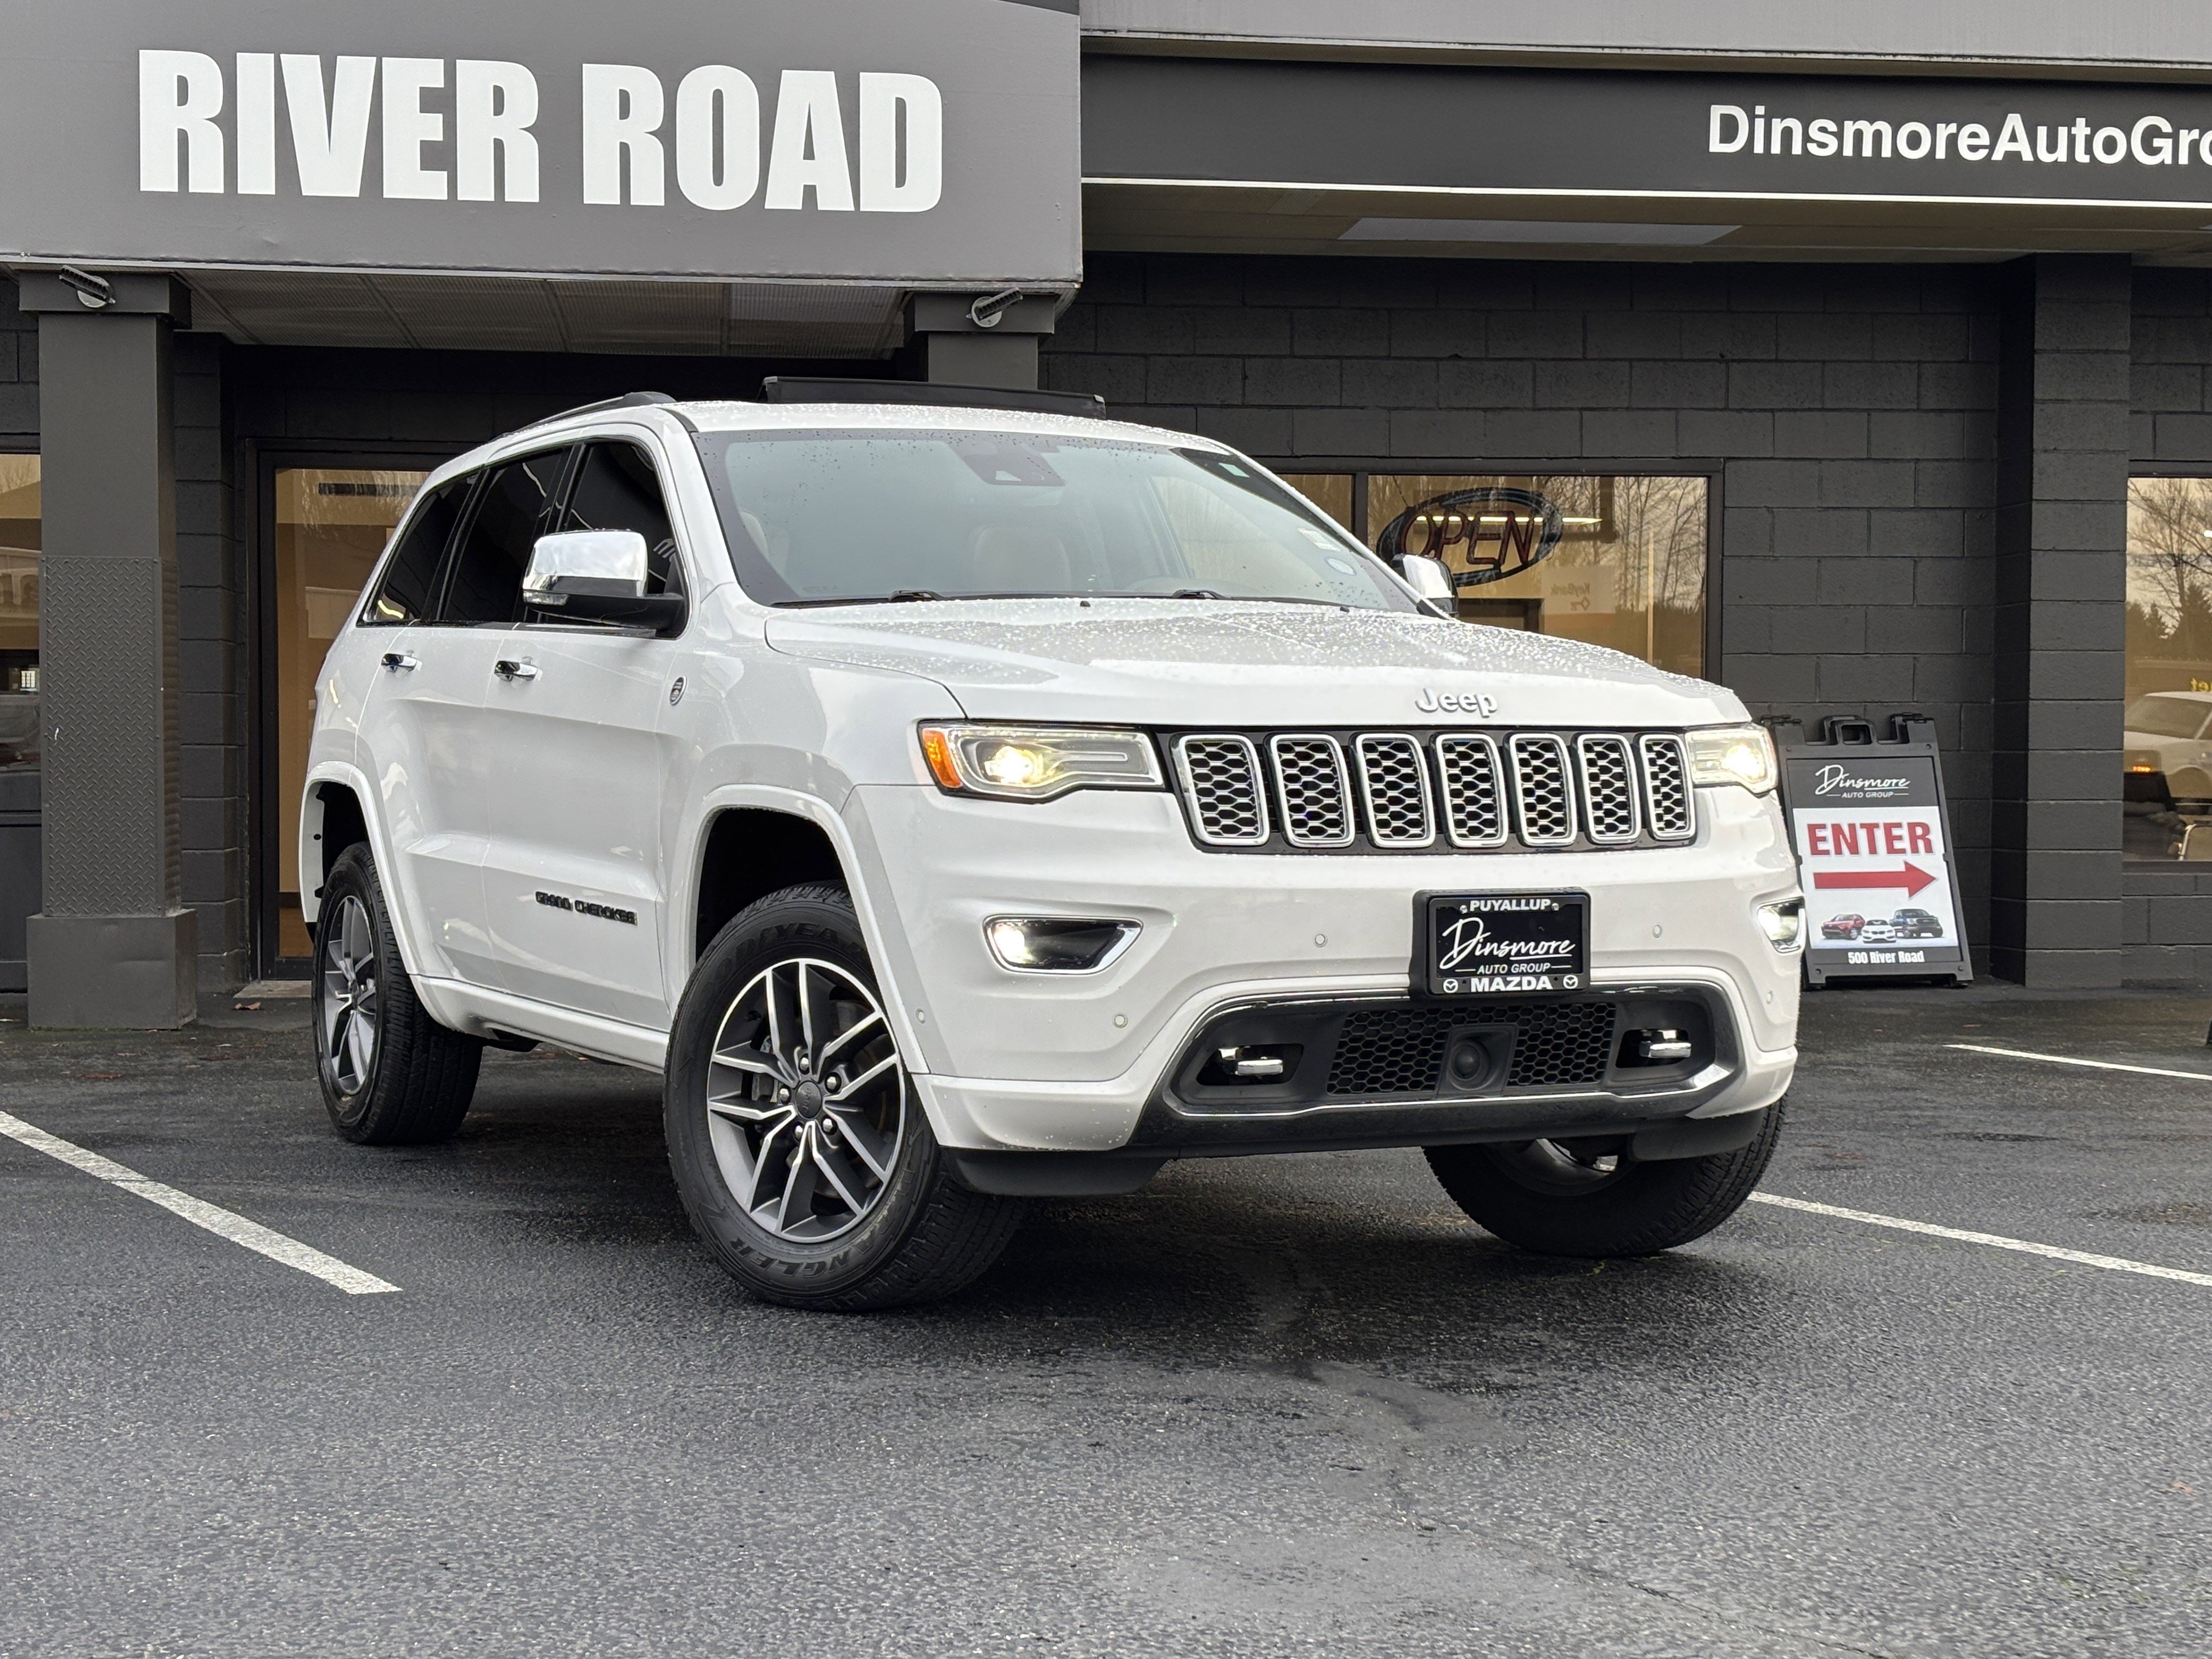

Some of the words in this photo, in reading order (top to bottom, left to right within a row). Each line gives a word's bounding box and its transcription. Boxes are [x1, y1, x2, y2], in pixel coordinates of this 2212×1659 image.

[139, 49, 539, 203] RIVER
[582, 63, 943, 212] ROAD
[1401, 510, 1535, 565] OPEN
[1415, 687, 1498, 718] Jeep
[1815, 764, 1911, 795] Dinsmore
[1807, 822, 1933, 855] ENTER
[1469, 899, 1551, 912] PUYALLUP
[1439, 917, 1576, 969] Dinsmore
[1848, 951, 1868, 964] 500
[1870, 951, 1897, 964] River
[1898, 950, 1926, 963] Road
[1470, 975, 1553, 992] MAZDA
[1477, 964, 1508, 975] AUTO
[1511, 963, 1551, 974] GROUP
